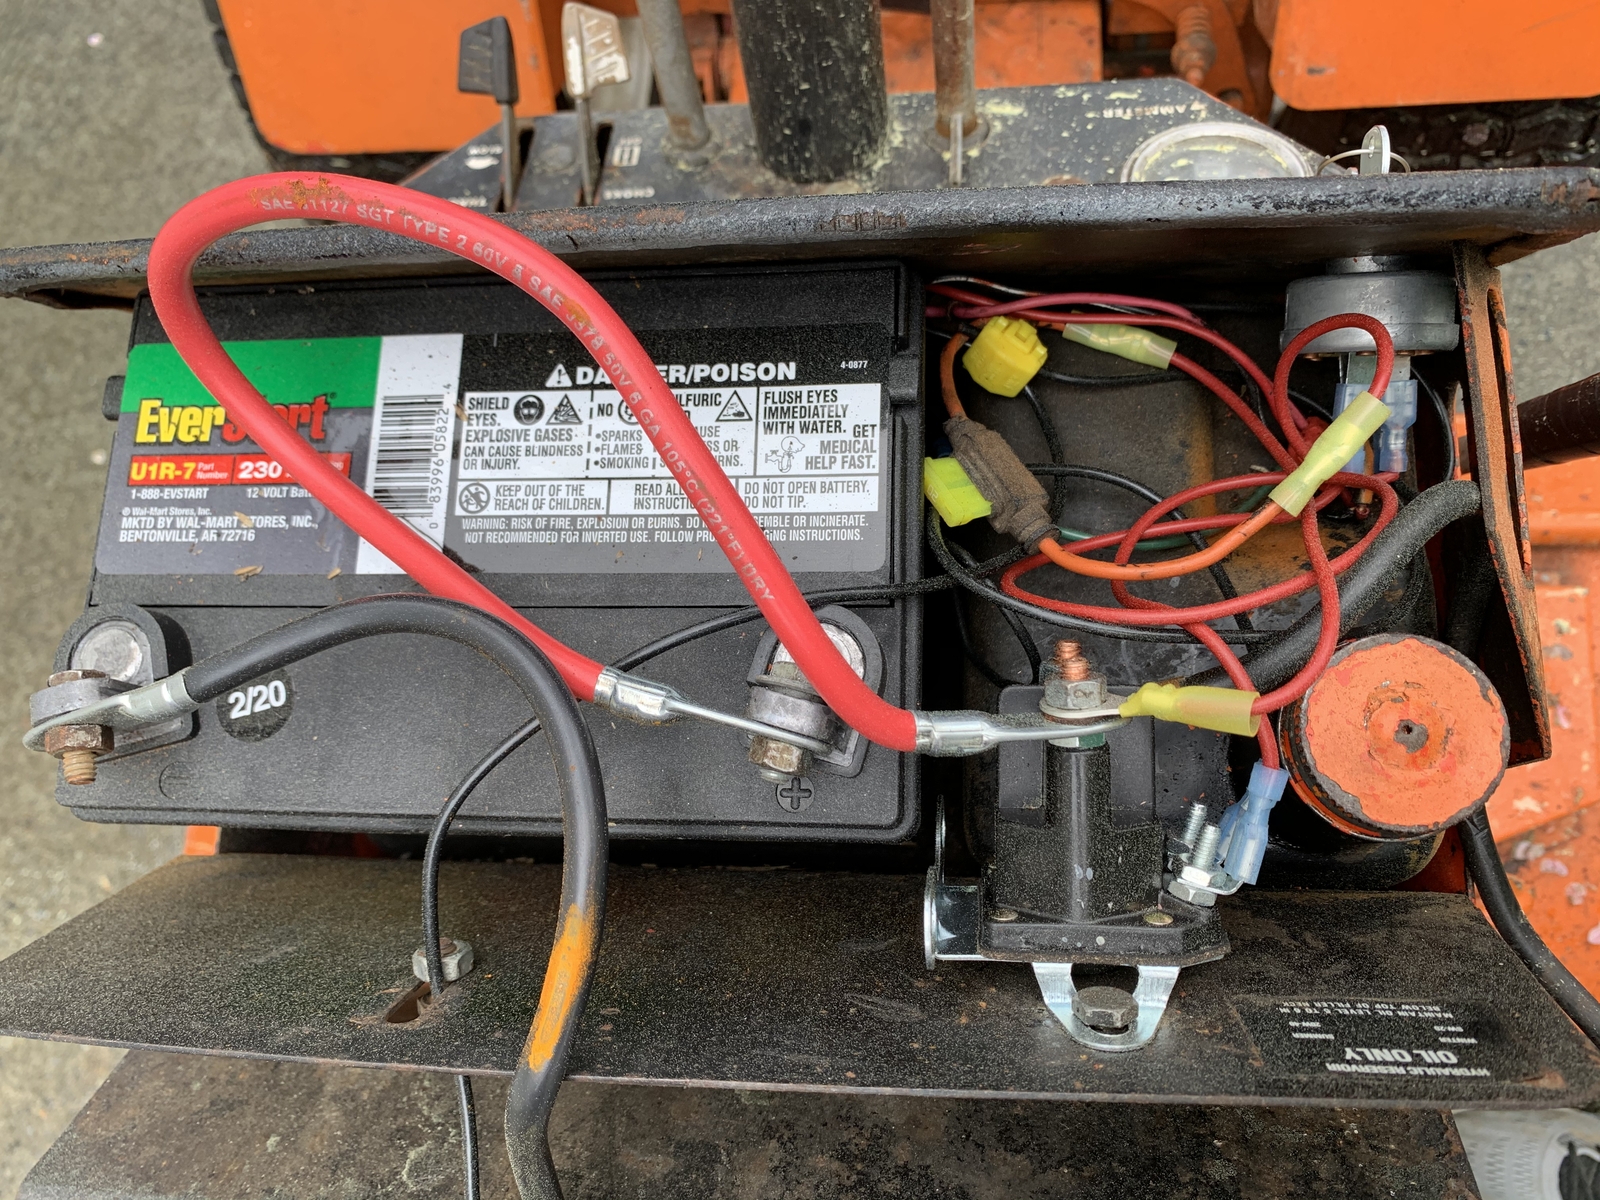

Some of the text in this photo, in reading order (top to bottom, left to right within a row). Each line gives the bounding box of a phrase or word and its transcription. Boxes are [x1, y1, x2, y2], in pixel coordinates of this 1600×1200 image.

[261, 198, 294, 211] SAE
[356, 204, 395, 225] SGT
[401, 214, 451, 244] TYPE
[455, 234, 468, 250] 2
[472, 241, 509, 269] 60V
[528, 275, 564, 311] SAE
[629, 391, 642, 405] 6
[639, 408, 662, 438] GA
[840, 361, 868, 369] 4-0877
[575, 362, 796, 386] DAR/POISON
[468, 397, 509, 411] SHIELD
[675, 393, 722, 407] LFURIC
[764, 389, 838, 405] FLUSH EYES
[597, 403, 613, 417] NO
[763, 404, 848, 420] IMMEDIATELY
[134, 395, 329, 444] EverSrt
[467, 413, 501, 427] EYES.
[763, 420, 847, 435] WITH WATER.
[853, 424, 877, 438] GET
[465, 428, 573, 443] EXPLOSIVE GASES
[601, 430, 642, 442] SPARKS
[464, 444, 583, 457] CAN CAUSE BLINDNESS
[601, 444, 643, 456] FLAMES
[724, 440, 739, 452] OR
[820, 440, 877, 455] MEDICAL
[428, 407, 451, 503] 83996 05822
[463, 458, 520, 470] OR INJURY.
[600, 457, 649, 469] SMOKING
[805, 455, 876, 470] HELP FAST.
[130, 462, 197, 480] U1R-7
[238, 461, 283, 479] 230
[196, 471, 228, 480] Number
[131, 487, 209, 499] 1-888-EVSTART
[246, 488, 259, 499] 12
[262, 487, 289, 499] VOLT
[495, 484, 585, 498] KEEP OUT OF THE
[634, 484, 662, 497] READ
[744, 479, 870, 494] DO NOT OPEN BATTERY.
[494, 498, 605, 511] REACH OF CHILDREN.
[744, 495, 806, 509] DO NOT TIP.
[132, 507, 212, 517] Wal-Mart Stores, Inc.
[122, 517, 154, 529] MKTD
[157, 517, 173, 529] BY
[175, 516, 238, 528] WAL-MART
[241, 516, 289, 530] TORES,
[429, 522, 439, 530] 0
[462, 518, 509, 530] WARNING:
[511, 518, 533, 530] RISK
[535, 518, 548, 530] OF
[550, 518, 574, 531] FIRE,
[577, 517, 629, 530] EXPLOSION
[632, 517, 645, 529] OR
[648, 517, 683, 529] BURNS.
[686, 516, 700, 528] DO
[792, 516, 806, 528] OR
[809, 515, 869, 527] INCINERATE.
[119, 530, 255, 543] BENTONVILLE, AR 72716
[465, 531, 484, 543] NOT
[486, 531, 558, 543] RECOMMENDED
[560, 531, 580, 543] FOR
[582, 531, 628, 543] INVERTED
[630, 531, 651, 543] USE.
[654, 530, 694, 543] FOLLOW
[789, 529, 864, 542] INSTRUCTIONS.
[227, 680, 286, 720] 2/20
[1344, 1047, 1459, 1064] OIL ONLY
